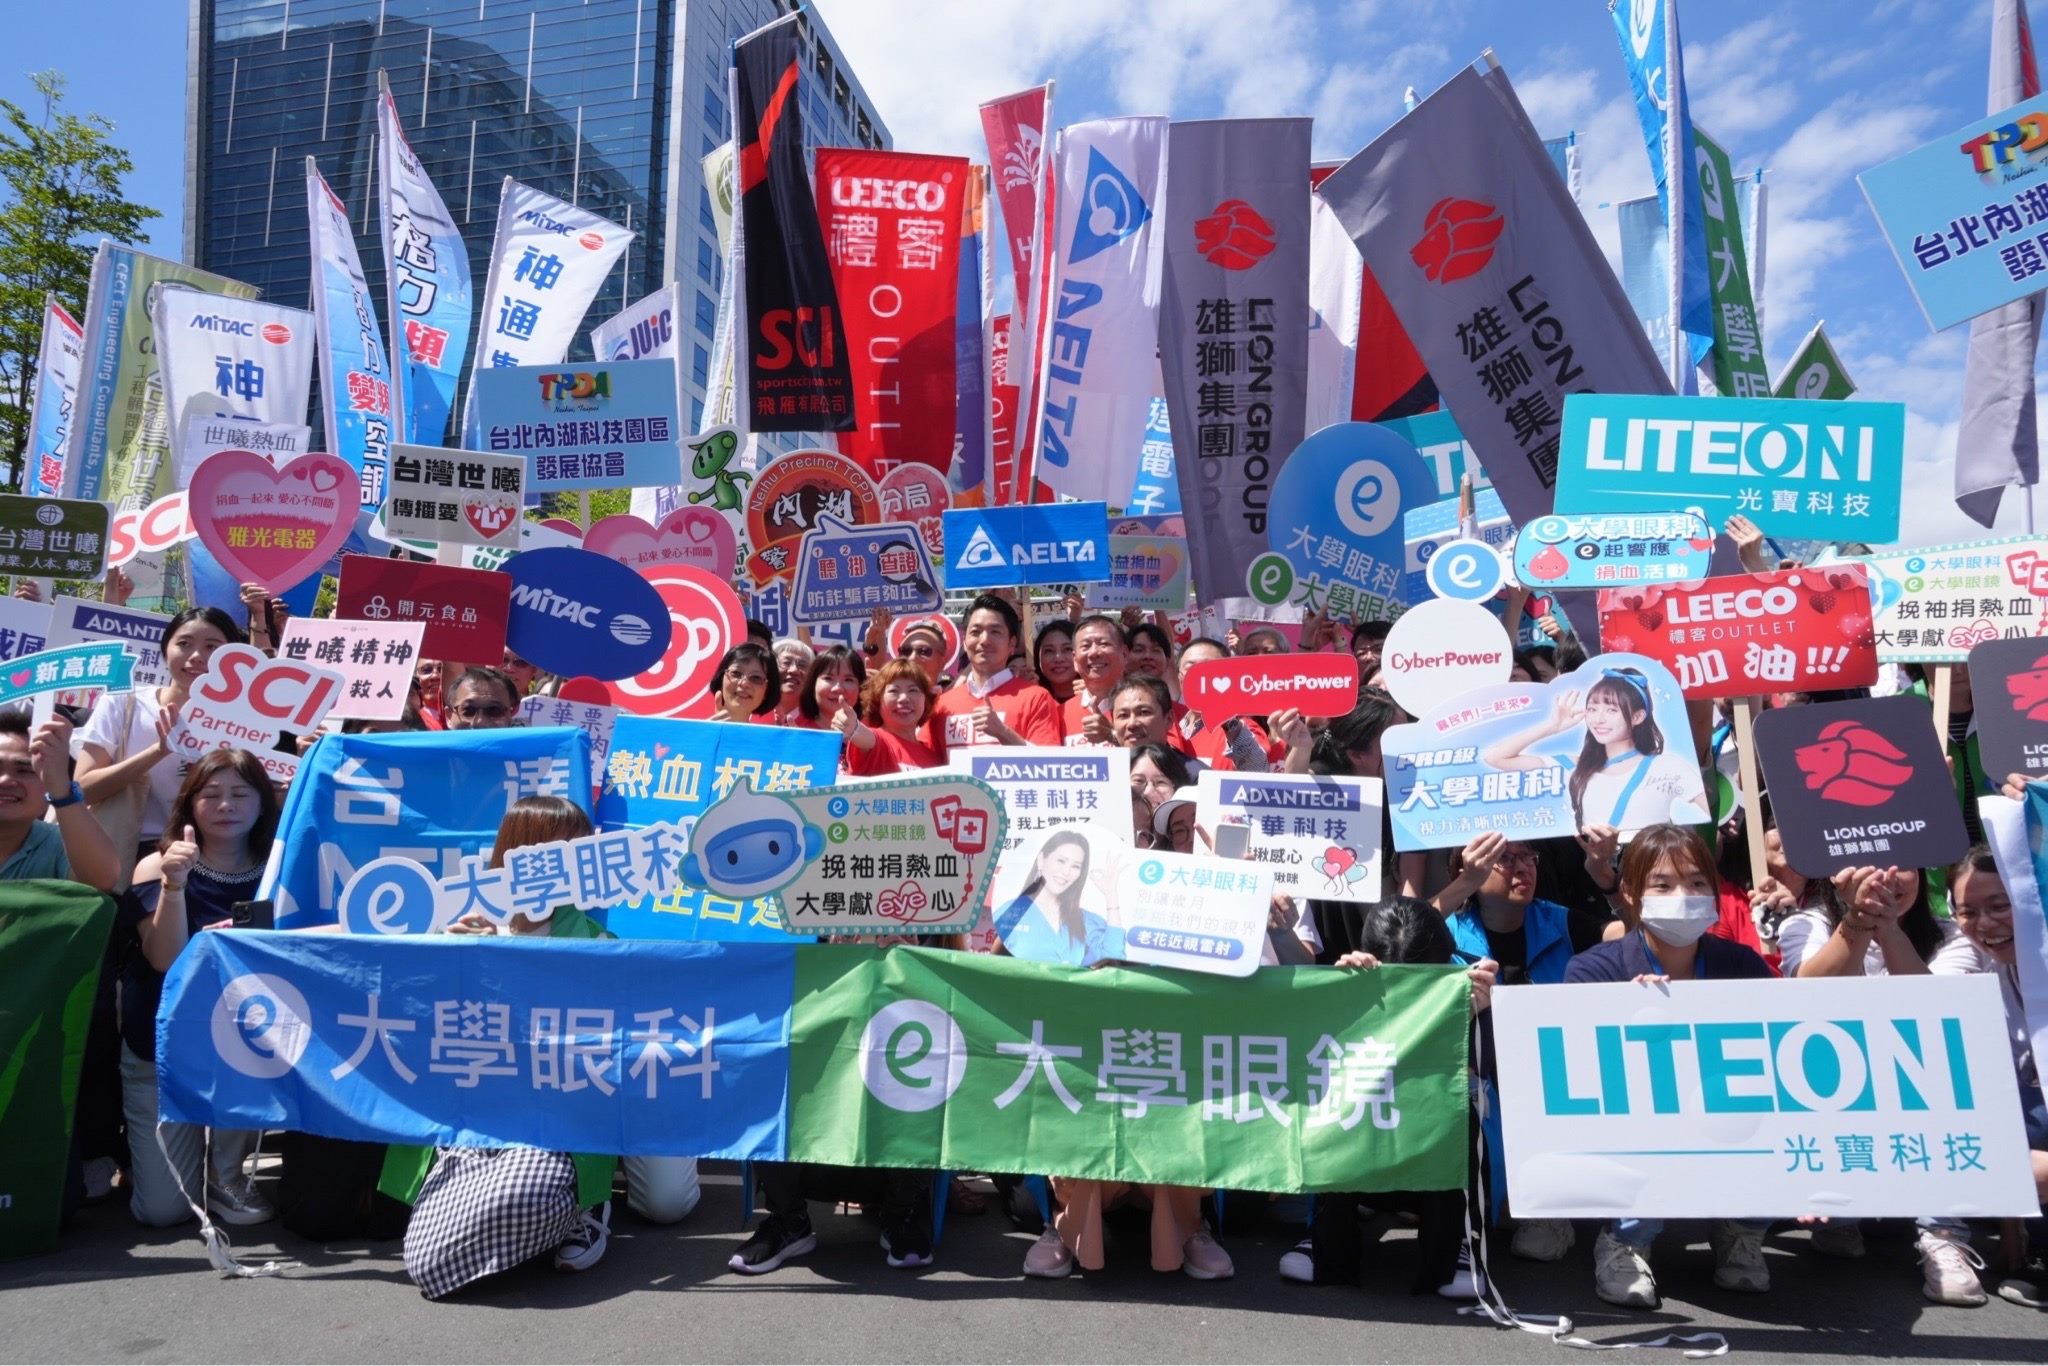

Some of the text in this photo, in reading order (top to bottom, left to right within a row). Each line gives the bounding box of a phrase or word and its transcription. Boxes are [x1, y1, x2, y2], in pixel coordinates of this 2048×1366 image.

[832, 177, 945, 212] LEECO
[831, 214, 945, 270] 禮客
[190, 314, 254, 338] MiTAC
[756, 306, 834, 370] SCI
[1507, 274, 1584, 387] LION
[98, 301, 123, 381] Engineering
[1195, 298, 1237, 460] 雄獅集團
[203, 425, 297, 452] 世曦熱血
[489, 416, 669, 451] 台北內湖科技園區
[1585, 417, 1875, 482] LITEON
[394, 455, 520, 494] 台灣世曦
[536, 451, 625, 481] 發展協會
[750, 456, 875, 512] Neihu Precinct TCPD
[1736, 487, 1871, 518] 光寶科技
[226, 525, 317, 549] 雅光電器
[1573, 515, 1700, 541] 大學眼科
[1012, 539, 1096, 566] DELTA
[1286, 524, 1402, 598] 大學眼科
[1603, 541, 1670, 558] 起響應
[1930, 555, 2001, 571] 大學眼科
[1594, 564, 1689, 581] 捐血活動
[1929, 574, 2001, 591] 大學眼鏡
[397, 599, 478, 623] 開元食品
[510, 584, 602, 629] MiTAC
[1666, 586, 1798, 624] LEECO
[1897, 597, 2033, 620] 挽袖捐熱血
[286, 636, 413, 665] 世曦精神
[1391, 652, 1502, 673] CyberPower
[35, 653, 113, 686] 新高橋
[1200, 673, 1352, 695] I CyberPower
[200, 651, 336, 728] SCI
[349, 680, 394, 699] 救人
[187, 707, 272, 744] Partner
[524, 699, 615, 732] 中華票
[176, 729, 210, 752] for
[984, 759, 1098, 779] ADVANTECH
[999, 789, 1099, 810] 華科技
[1232, 785, 1348, 809] ADVANTECH
[1399, 766, 1566, 812] 大學眼科
[854, 798, 926, 816] 大學眼科
[1419, 806, 1556, 837] 視力清晰閃亮亮
[854, 823, 926, 841] 大學眼鏡
[1242, 814, 1348, 841] 華科技
[1823, 820, 1926, 841] LION GROUP
[1828, 838, 1891, 857] 雄獅集團
[444, 823, 692, 926] 大學眼科
[822, 853, 959, 880] 挽袖捐熱血
[1169, 866, 1259, 895] 大學眼科
[1137, 930, 1232, 956] 老花近視雷射
[330, 993, 721, 1099] 大學眼科
[993, 1018, 1400, 1132] 大學眼鏡
[1537, 1017, 1976, 1117] LITEON
[1784, 1131, 1987, 1174] 光寶科技
